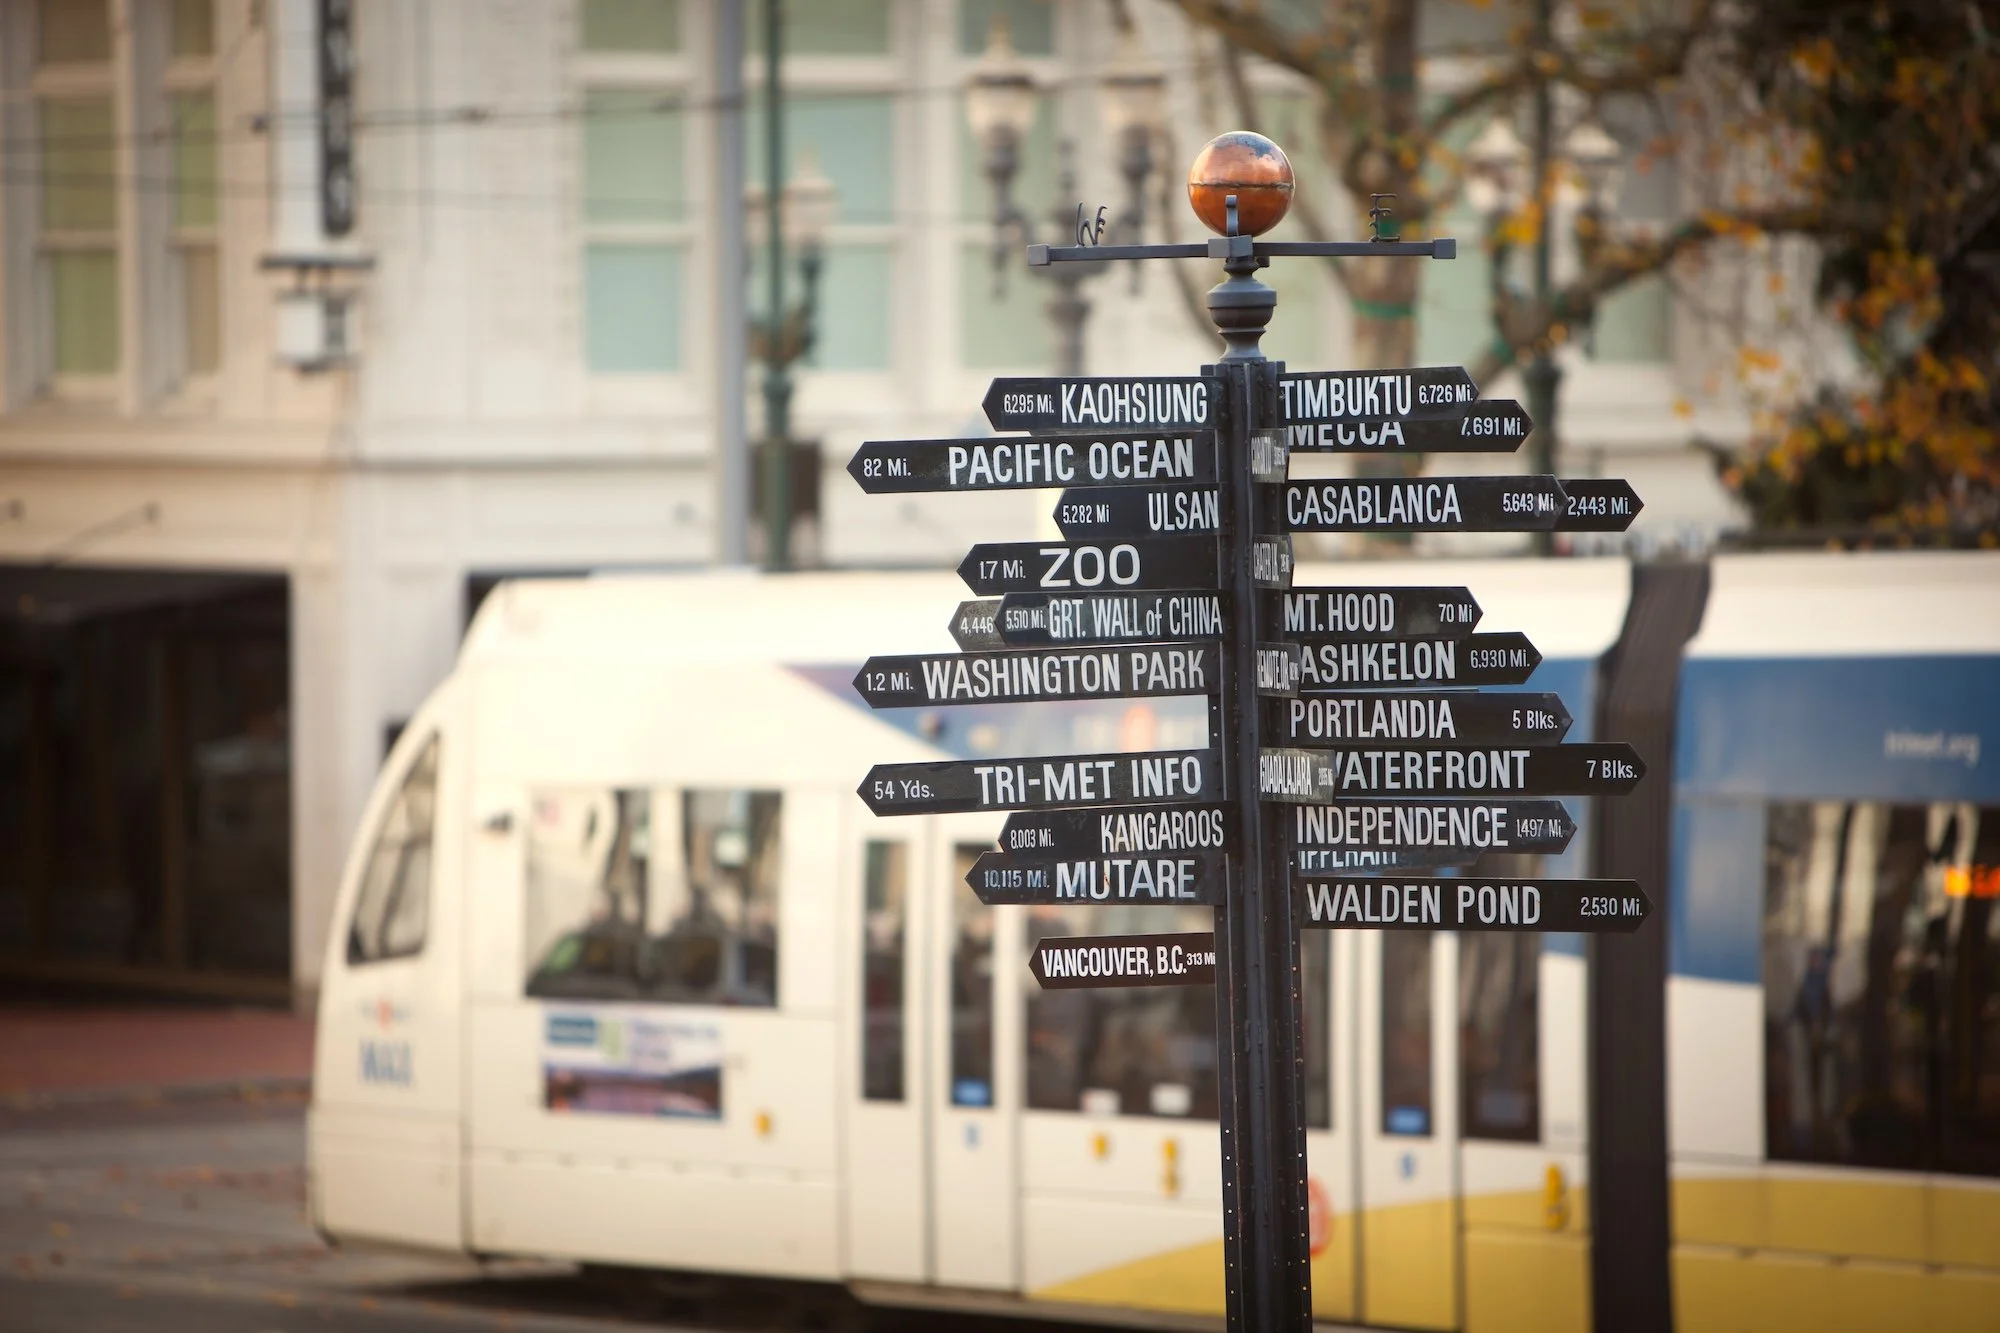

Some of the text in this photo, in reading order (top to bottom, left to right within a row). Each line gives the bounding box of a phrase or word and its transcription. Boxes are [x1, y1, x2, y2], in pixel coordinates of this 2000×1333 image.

[1004, 382, 1208, 424] 6,295 Mi. KAOHSIUNG
[1279, 375, 1474, 419] TIMBUKTU 6,726 Mi.
[1288, 421, 1405, 446] MECCA
[1503, 416, 1525, 436] Mi.
[863, 438, 1194, 485] 82 Mi. PACIFIC OCEAN
[1095, 503, 1110, 523] Mi
[1148, 490, 1220, 531] ULSAN
[1287, 483, 1462, 525] CASABLANCA
[1567, 496, 1632, 518] 2,443 Mi.
[979, 543, 1141, 588] 1.7 Mi. ZOO
[960, 616, 994, 636] 4,446
[1005, 596, 1223, 638] 5,510 Mi. GRT. WALL of CHINA
[1283, 593, 1473, 632] MT. HOOD 70 Mi
[866, 650, 1206, 700] 1.2 Mi. WASHINGTON PARK
[1301, 641, 1456, 684] ASHKELON
[1470, 649, 1506, 669] 6,930
[1509, 649, 1531, 668] Mi.
[1290, 698, 1558, 739] PORTLANDIA 5 Blks.
[874, 756, 1202, 805] 54 Yds. TRI-MET INFO
[1260, 755, 1312, 796] GUADALAJARA
[1586, 760, 1596, 779] 7
[1602, 759, 1638, 779] Blks.
[1039, 828, 1055, 847] Mi.
[1101, 809, 1224, 854] KANGAROOS
[1297, 806, 1564, 848] INDEPENDENCE 1,497 Mi.
[984, 859, 1196, 900] 10,115 Mi. MUTARE
[1306, 883, 1643, 925] WALDEN POND 2,530 Mi.
[1041, 947, 1154, 979] VANCOUVER,
[1157, 945, 1188, 975] B.C.
[1186, 952, 1203, 966] 313
